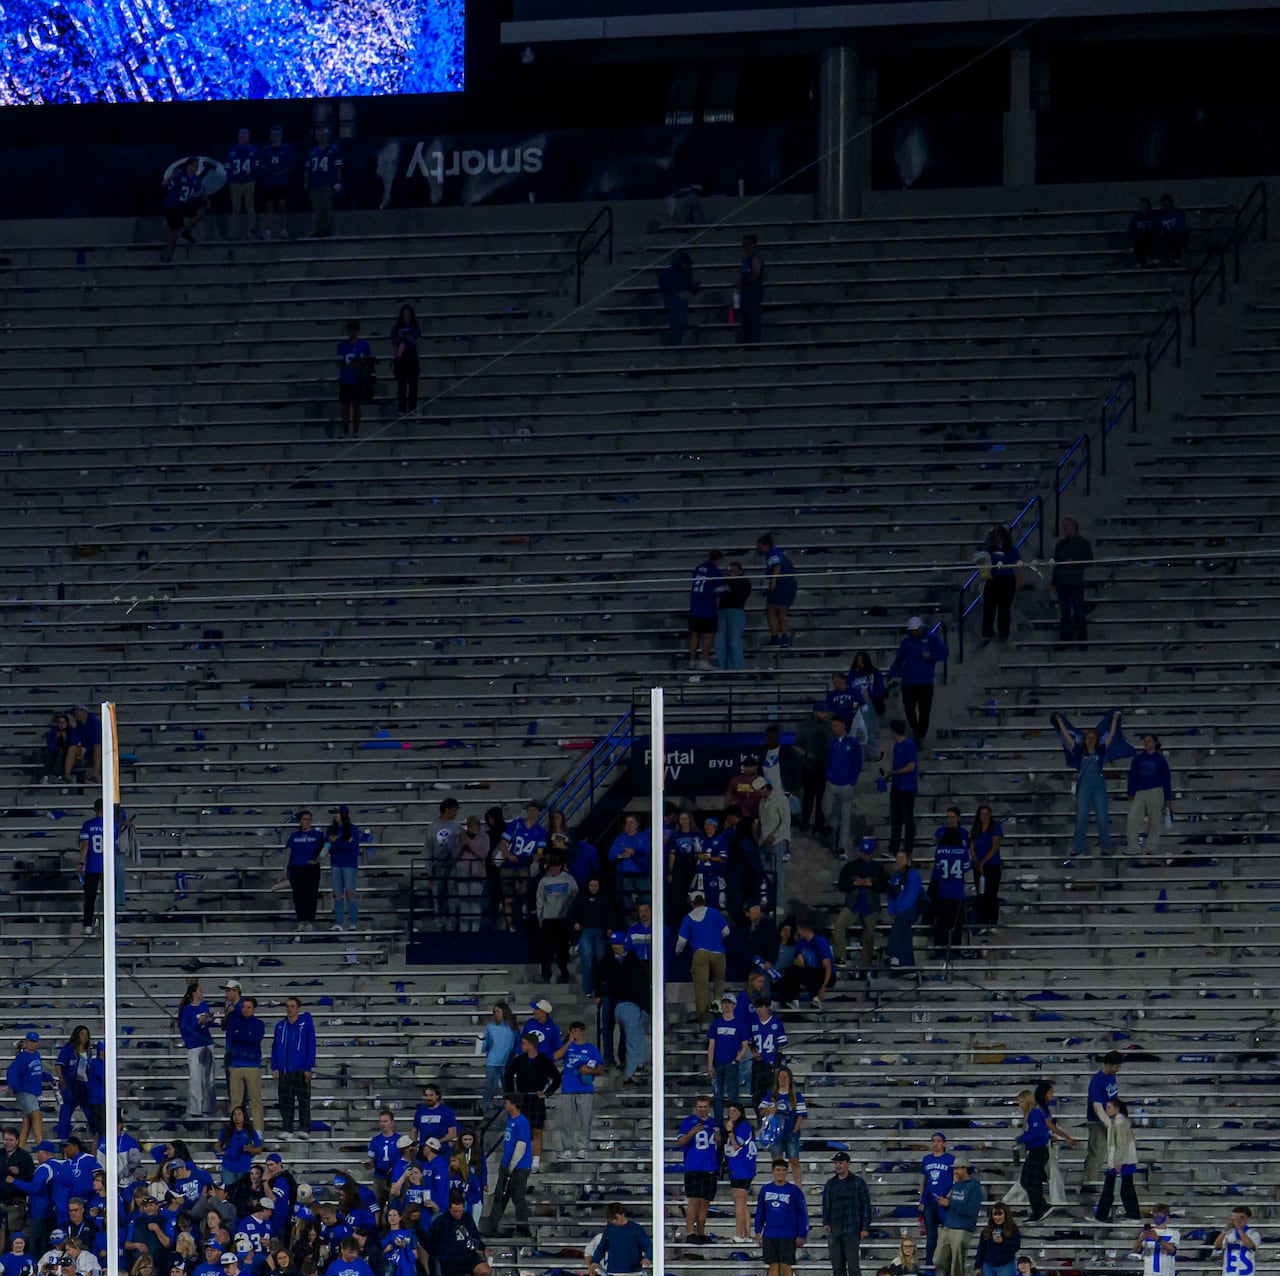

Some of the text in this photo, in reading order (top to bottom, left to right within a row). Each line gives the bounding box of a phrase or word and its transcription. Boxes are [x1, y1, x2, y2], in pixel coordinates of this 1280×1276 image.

[644, 749, 694, 765] Prtal
[709, 759, 733, 768] BYU
[756, 1033, 774, 1052] 34
[383, 1148, 389, 1162] 1
